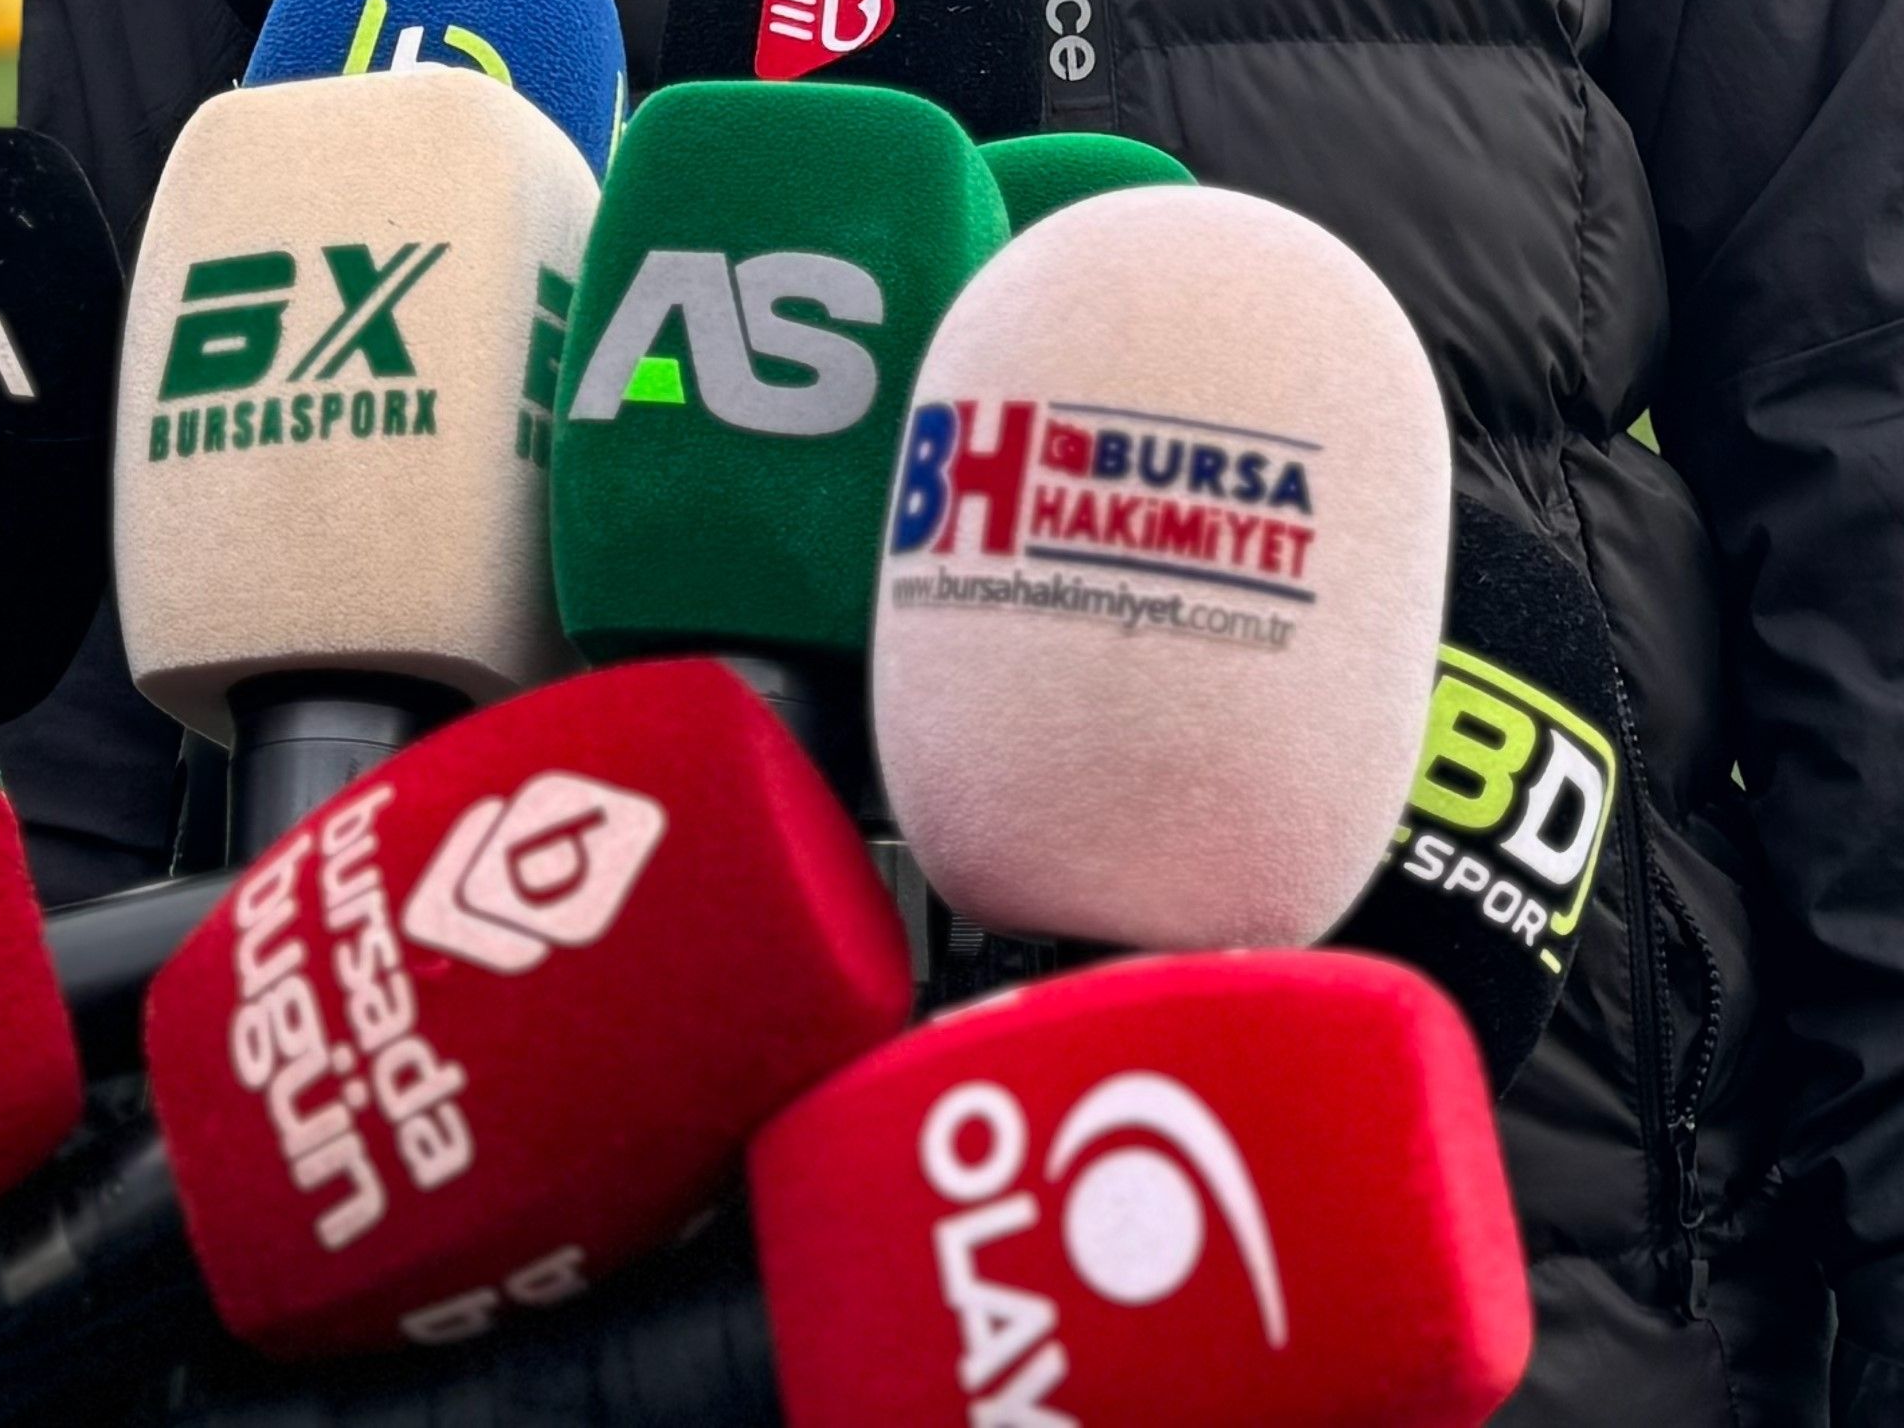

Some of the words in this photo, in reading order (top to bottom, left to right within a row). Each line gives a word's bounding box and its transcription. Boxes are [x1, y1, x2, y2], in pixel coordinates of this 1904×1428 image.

[157, 242, 450, 401] BX
[568, 250, 884, 436] AS
[149, 389, 438, 463] BURSASPORX
[891, 400, 1037, 556] BH
[1091, 429, 1313, 515] BURSA
[1404, 835, 1547, 946] SPOR
[229, 834, 387, 1252] bugün
[317, 784, 476, 1190] bursada
